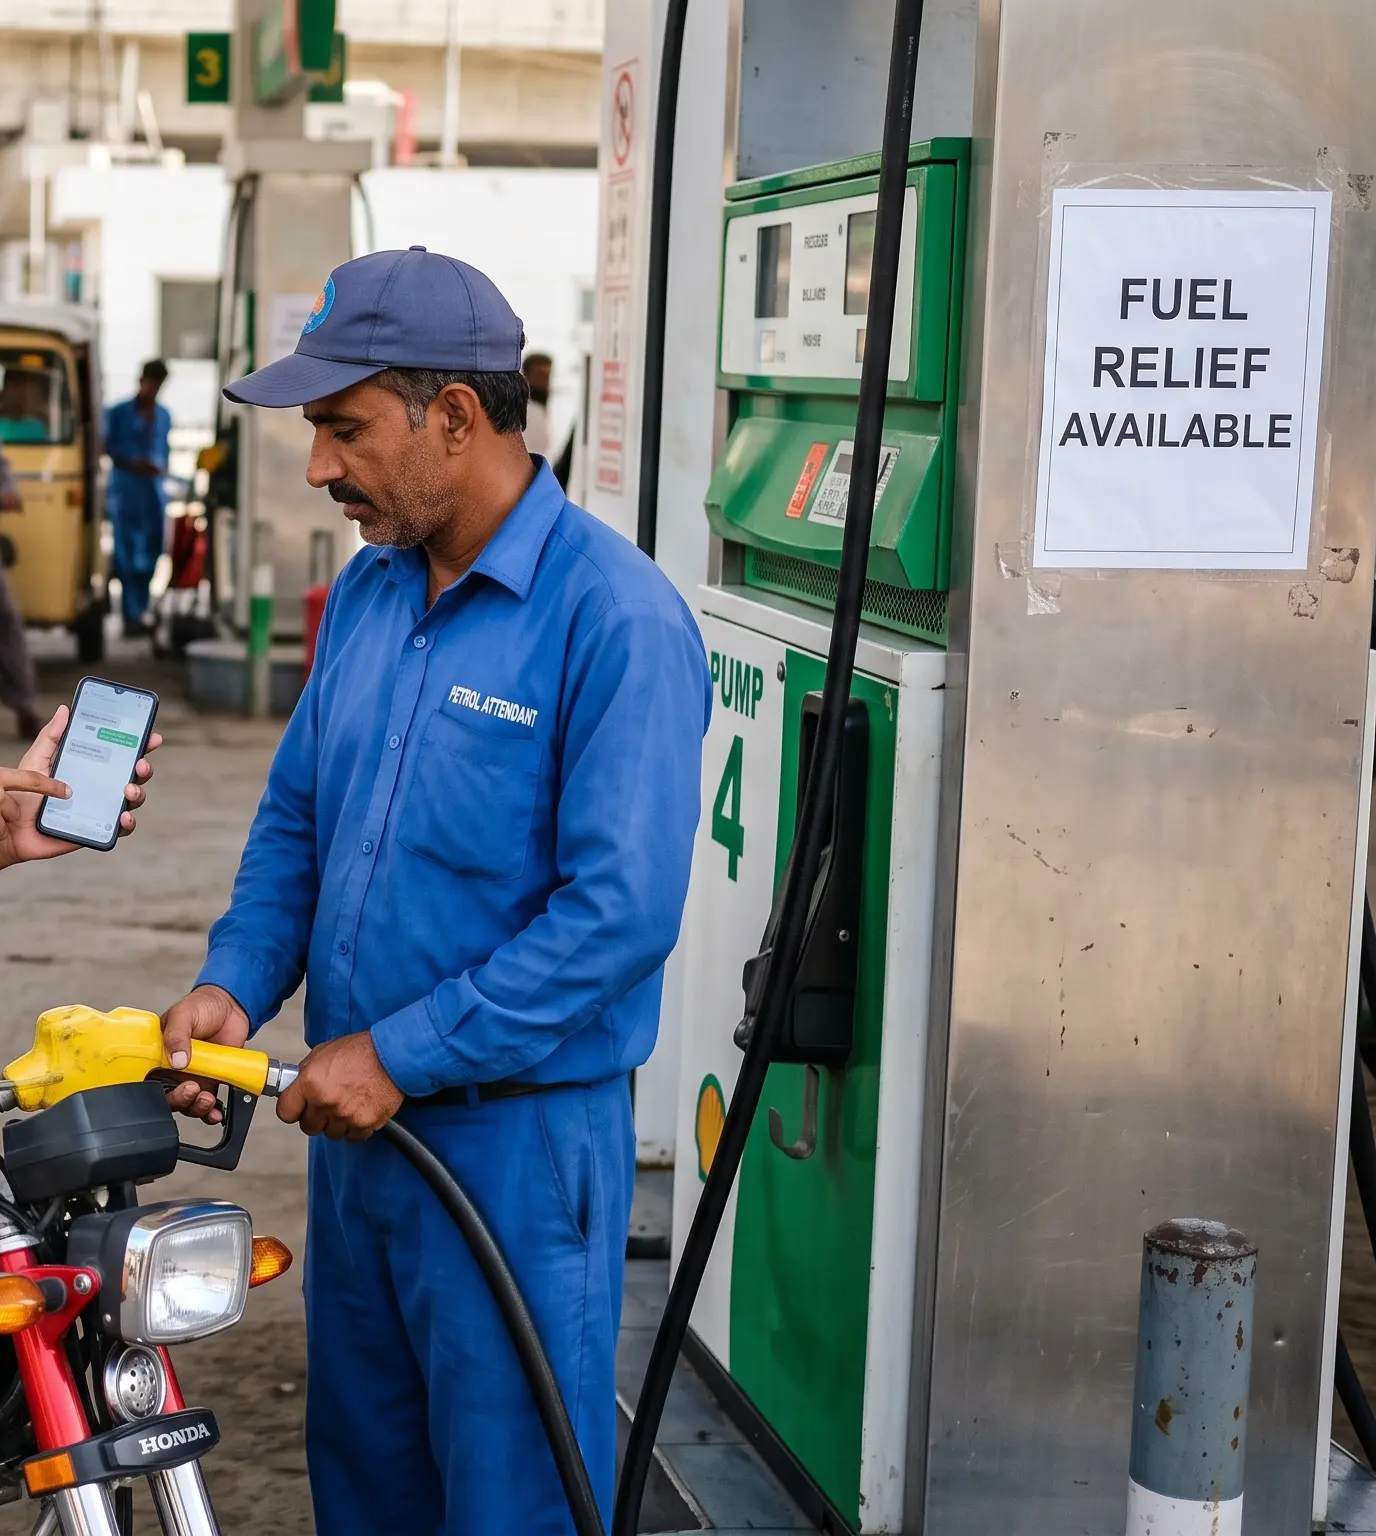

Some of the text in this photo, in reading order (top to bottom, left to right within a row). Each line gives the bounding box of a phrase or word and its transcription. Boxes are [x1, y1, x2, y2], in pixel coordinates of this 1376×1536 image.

[195, 48, 221, 87] 3
[1120, 278, 1248, 320] FUEL
[1093, 346, 1271, 389] RELIEF
[1058, 412, 1292, 448] AVAILABLE
[448, 685, 538, 728] PETROL ATTENDANT
[711, 651, 764, 720] PUMP
[711, 734, 745, 883] 4
[138, 1422, 211, 1455] HONDA
